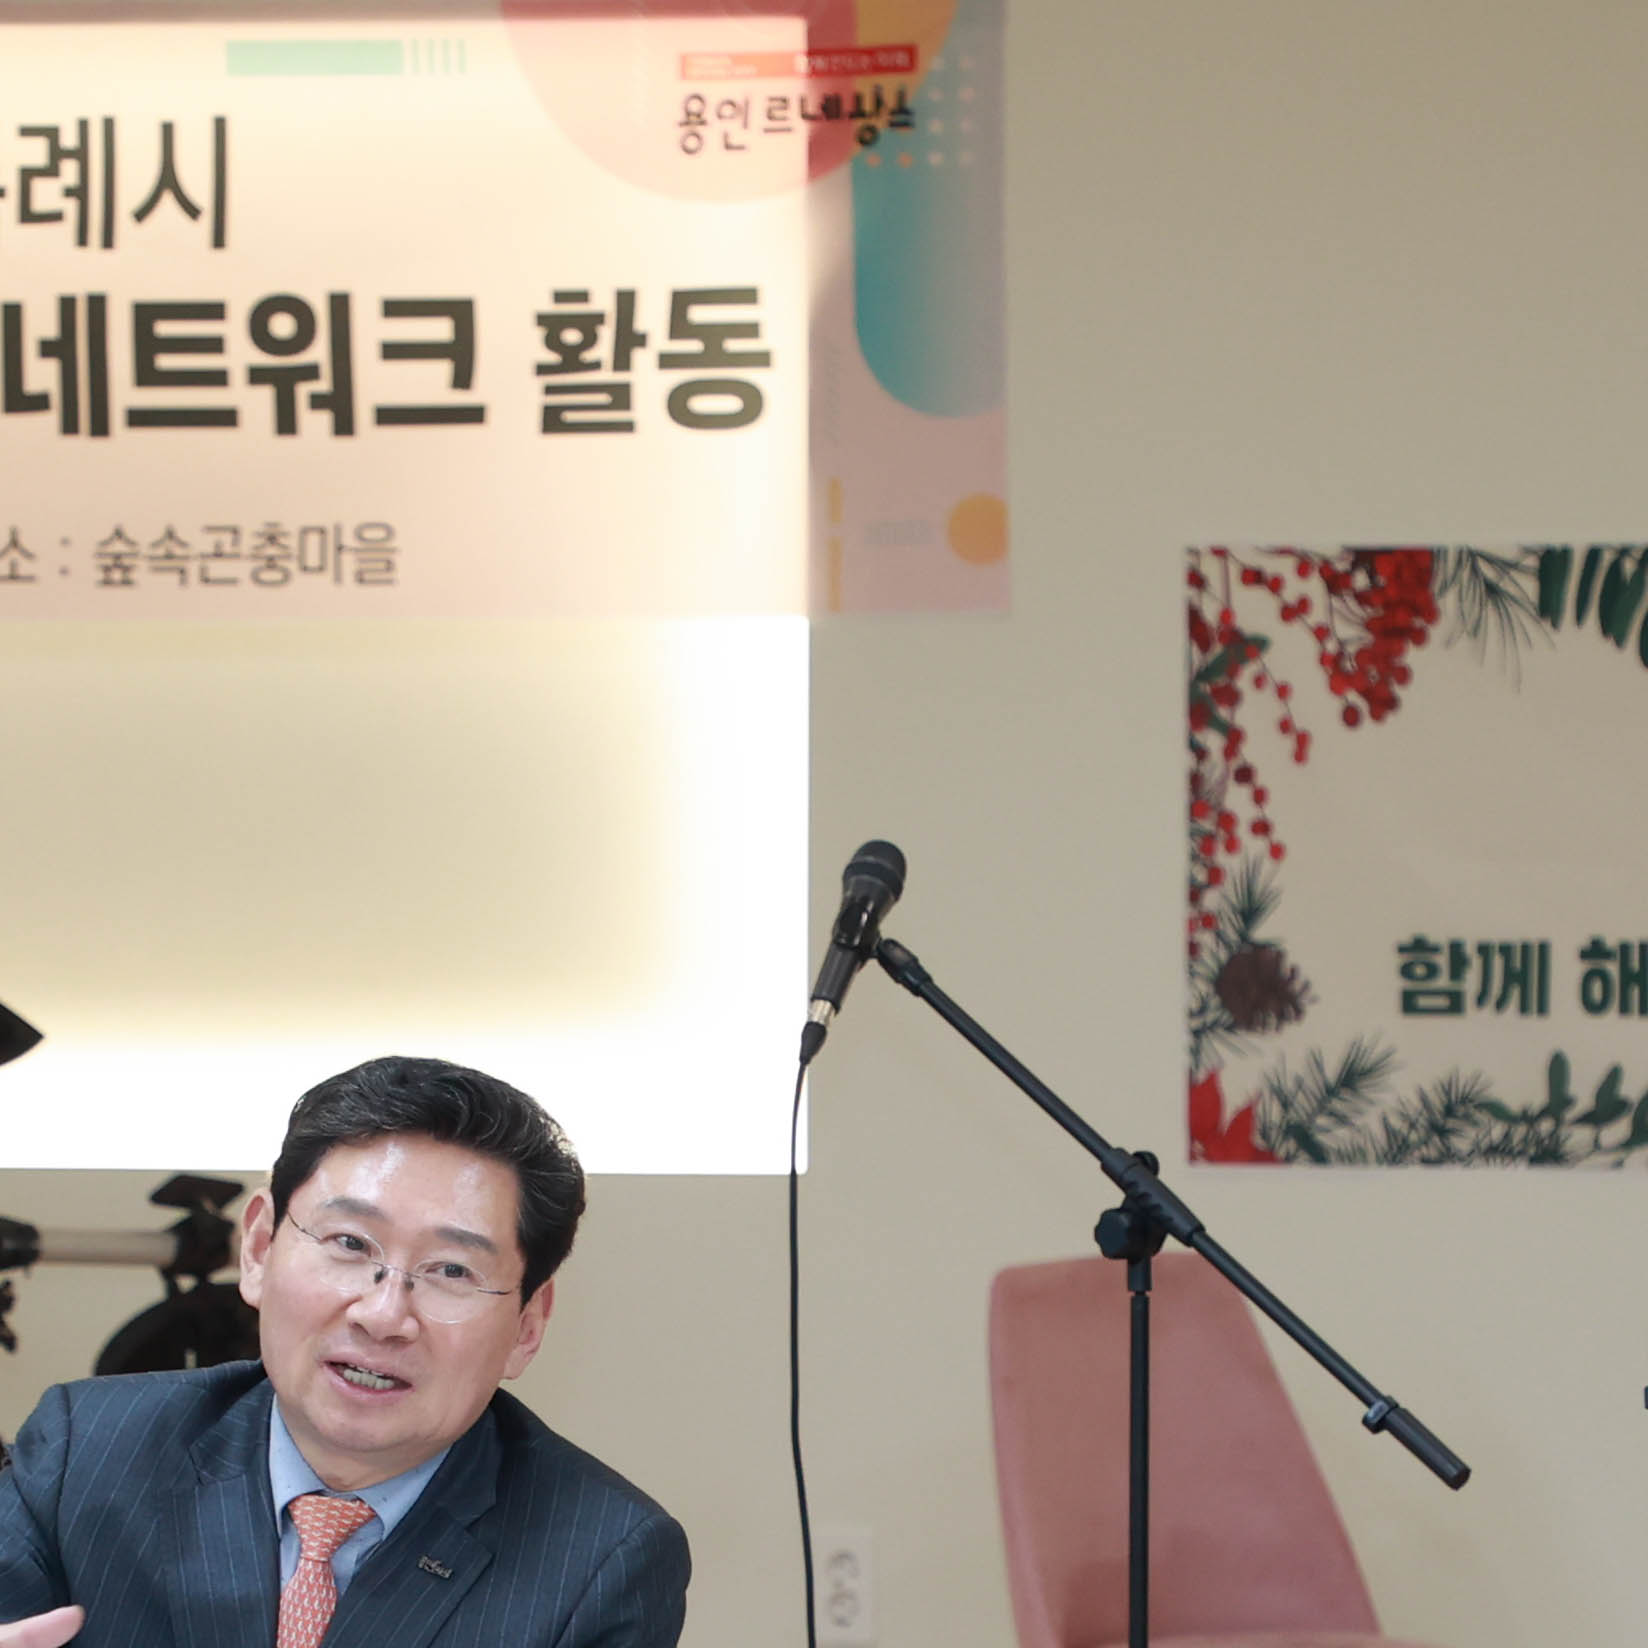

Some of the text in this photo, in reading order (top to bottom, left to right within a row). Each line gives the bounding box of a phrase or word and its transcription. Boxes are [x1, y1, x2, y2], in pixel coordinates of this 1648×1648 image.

[1, 291, 486, 437] 네트워크
[534, 287, 771, 434] 활동
[95, 522, 400, 588] 숲속곤충마을
[1397, 935, 1550, 1016] 함께
